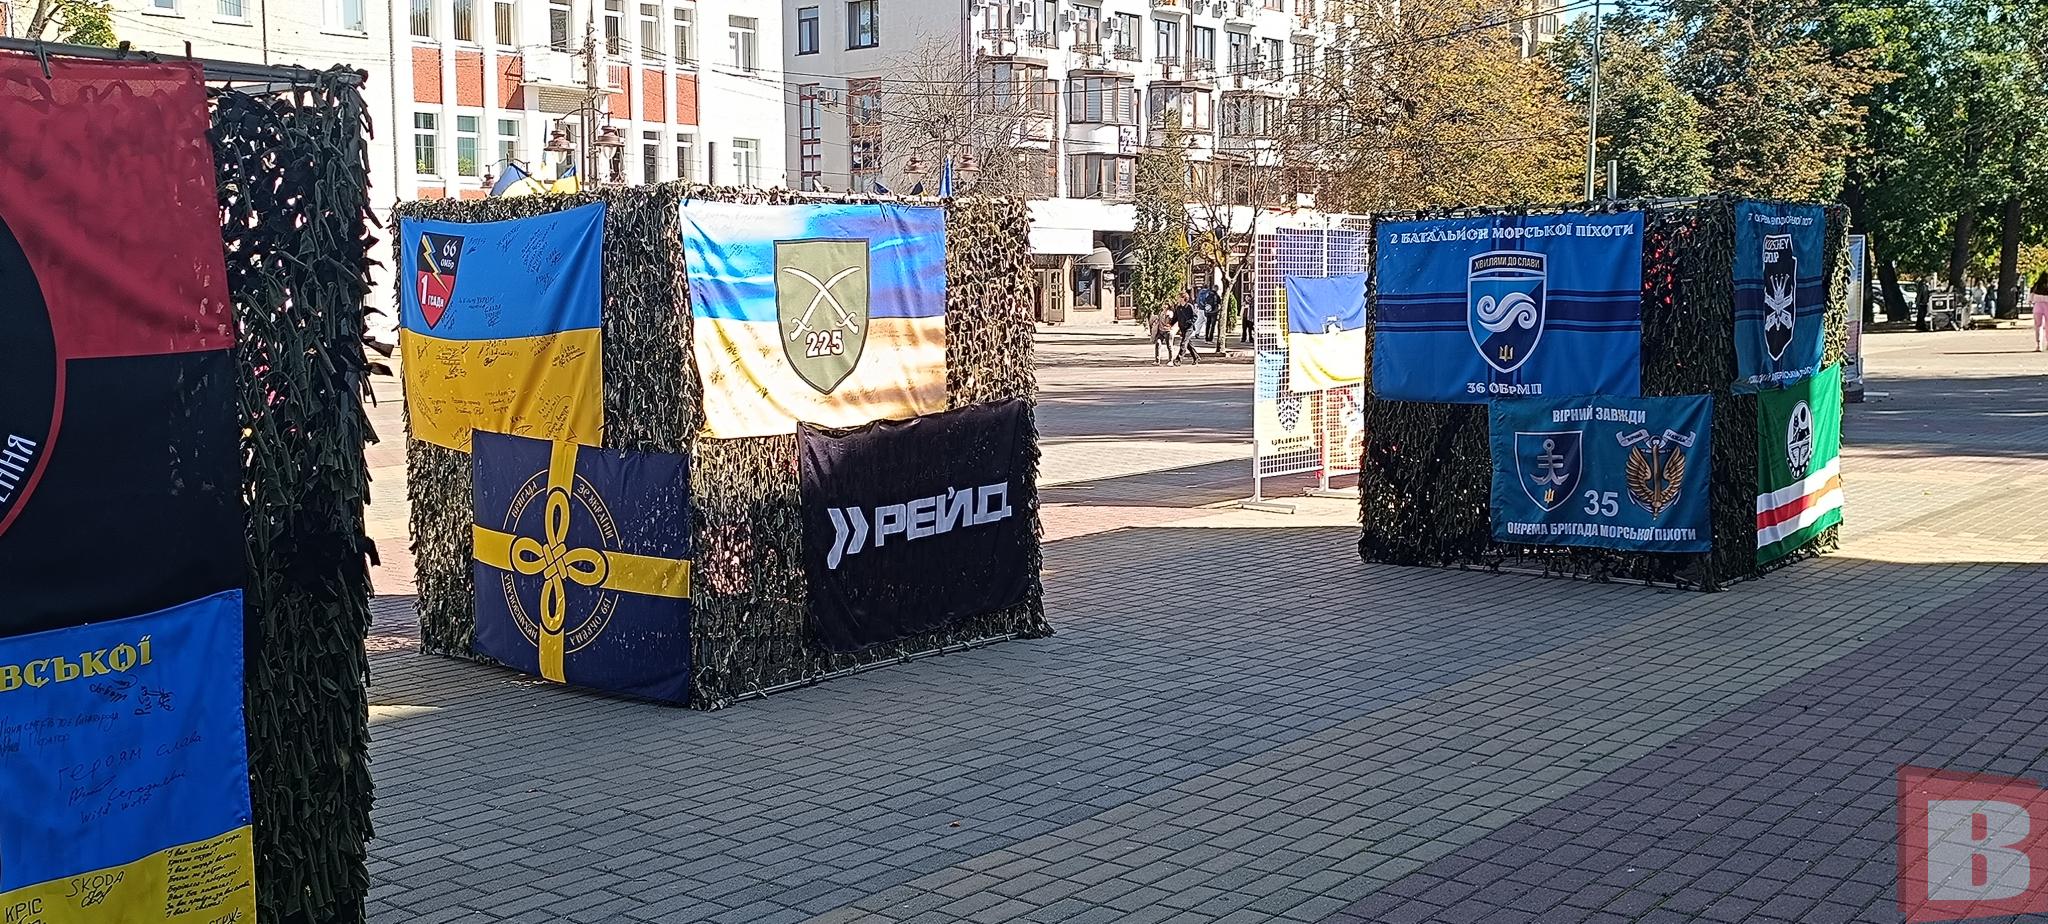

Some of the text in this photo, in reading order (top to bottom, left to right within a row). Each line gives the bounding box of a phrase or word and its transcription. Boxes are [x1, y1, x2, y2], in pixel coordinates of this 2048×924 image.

[1390, 222, 1634, 244] 2 БАТАЛЬЙОН МОРСЬКОЇ ПІХОТИ
[443, 240, 457, 258] 66
[1474, 256, 1540, 270] ХВИЛЯМИ ДО СЛАВИ
[421, 274, 428, 305] 1
[805, 329, 845, 358] 225
[1466, 382, 1542, 394] 36 ОБрМП
[1552, 405, 1646, 425] ВІРНИЙ ЗАВЖДИ
[0, 434, 37, 503] ННЯ
[874, 481, 1012, 548] РЕЙД
[1583, 489, 1619, 517] 35
[1507, 521, 1696, 541] ОКРЕМА БРИГАДА МОРСЬКОЇ ПІХОТИ
[65, 870, 125, 897] SKODA
